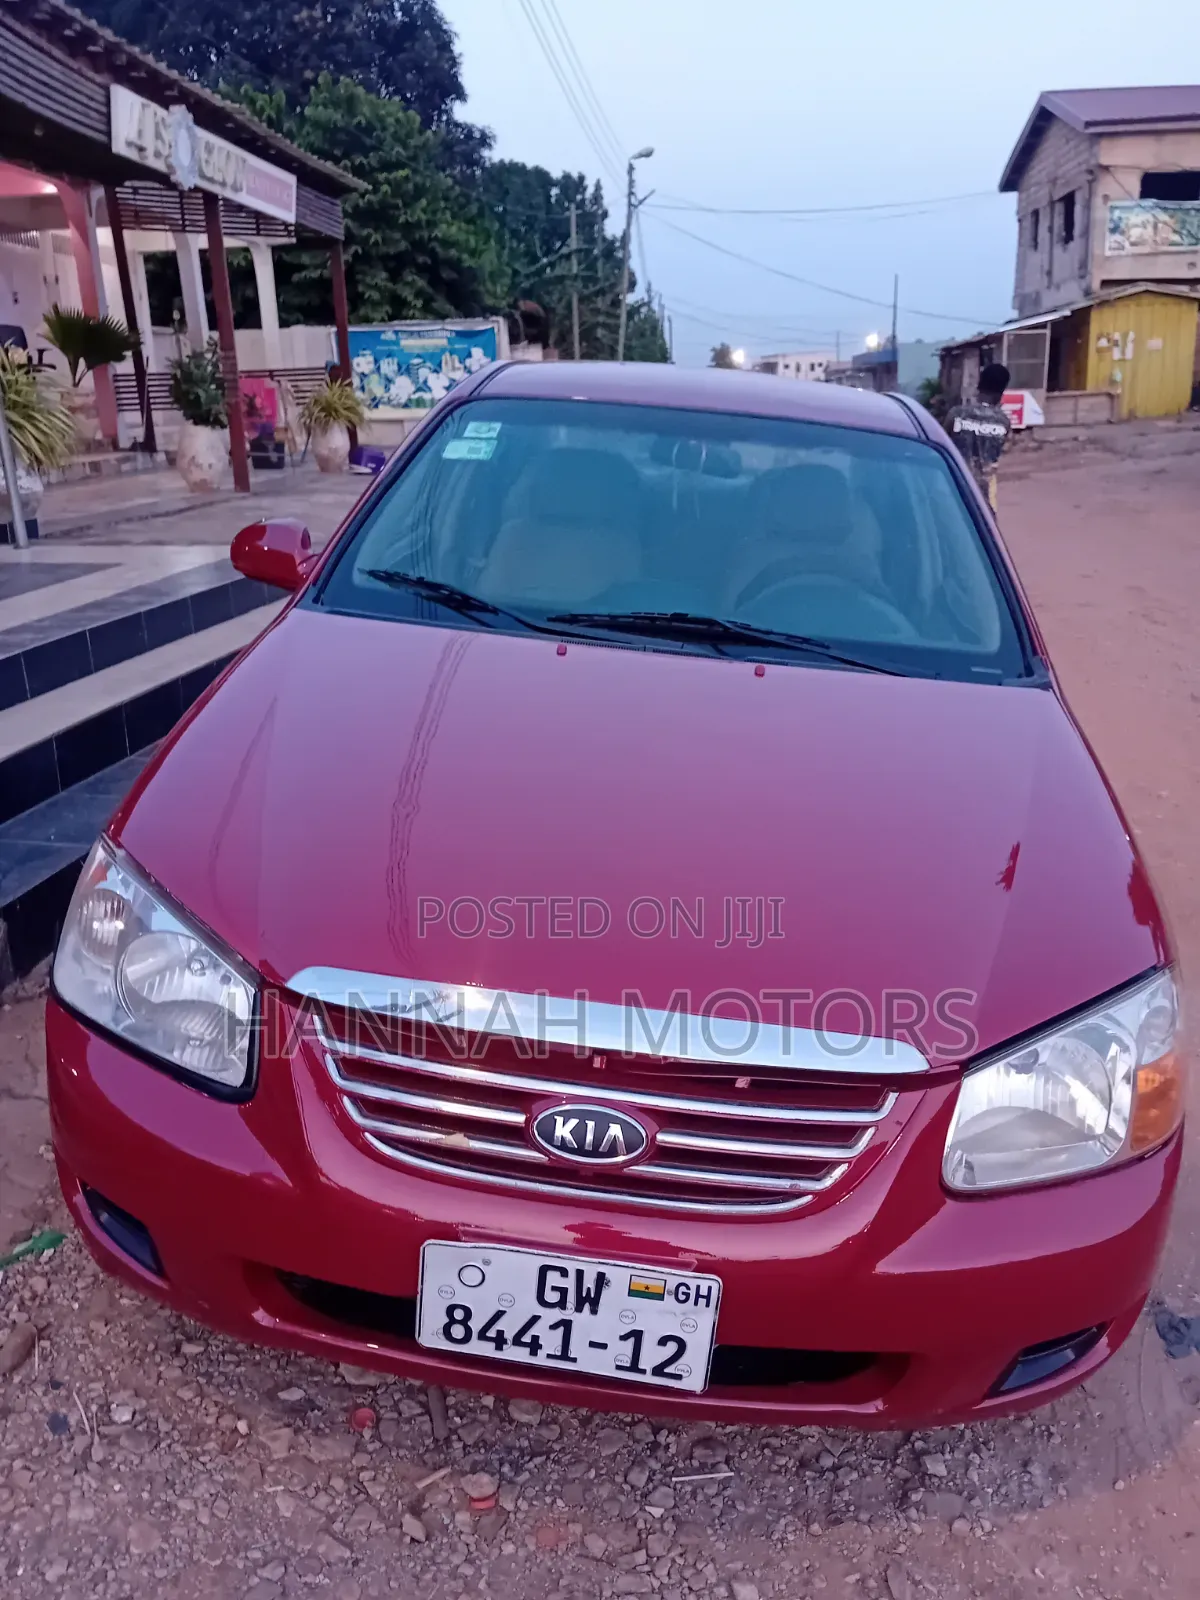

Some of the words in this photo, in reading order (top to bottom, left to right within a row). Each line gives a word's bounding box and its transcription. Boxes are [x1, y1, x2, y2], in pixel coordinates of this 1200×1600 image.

[553, 1115, 627, 1156] KIA
[536, 1264, 606, 1316] GW
[674, 1282, 712, 1308] GH
[442, 1303, 688, 1381] 8441-12
